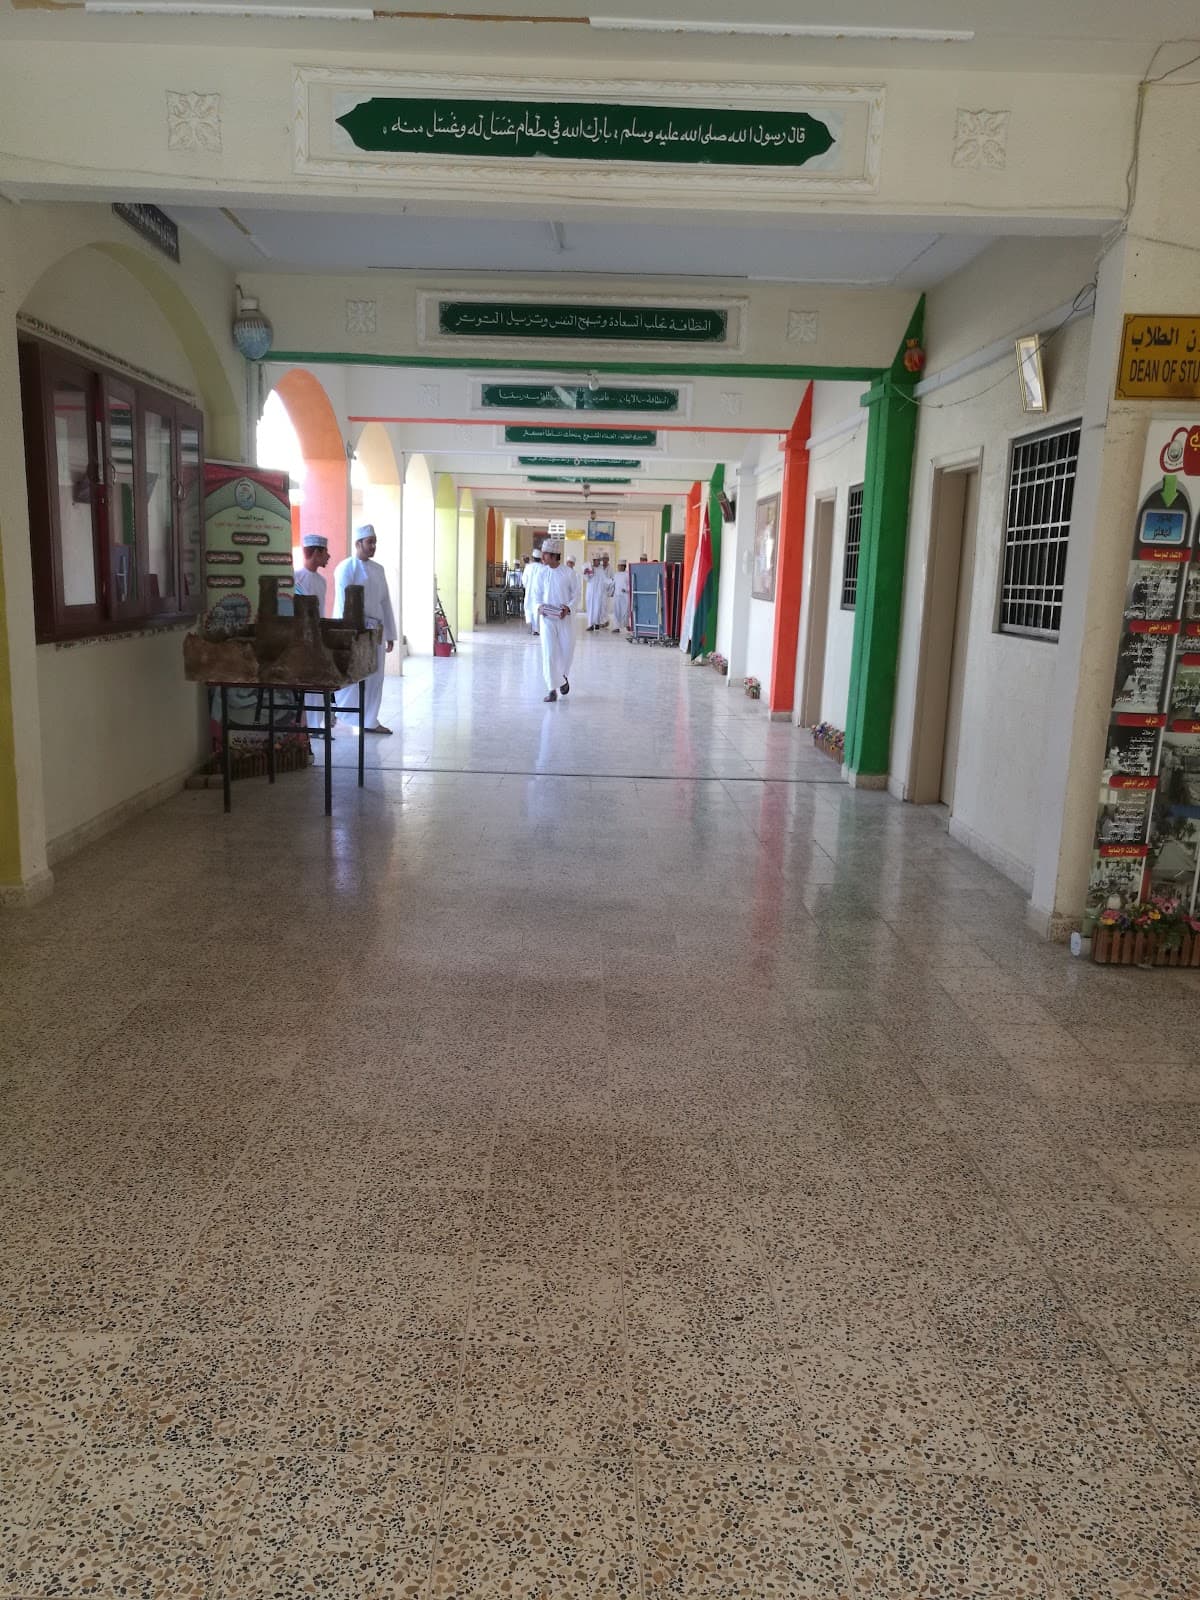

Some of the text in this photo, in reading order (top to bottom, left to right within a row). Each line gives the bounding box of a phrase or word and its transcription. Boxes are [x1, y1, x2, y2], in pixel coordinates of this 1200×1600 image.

[467, 114, 484, 138] له
[547, 115, 561, 145] في
[561, 118, 583, 139] الله
[582, 115, 614, 144] بارك
[654, 120, 680, 146] عليه
[679, 123, 702, 143] الله
[700, 123, 728, 144] صلى
[727, 126, 753, 143] الله
[752, 124, 787, 146] رسول
[789, 126, 806, 144] قال
[455, 311, 503, 327] التوتر
[506, 310, 548, 327] وتزيل
[549, 314, 577, 329] النفس
[609, 311, 643, 329] السعادة
[669, 317, 711, 332] النظافة
[1131, 326, 1179, 352] الطلاب
[1129, 359, 1160, 382] DEAN
[1161, 359, 1178, 382] OF
